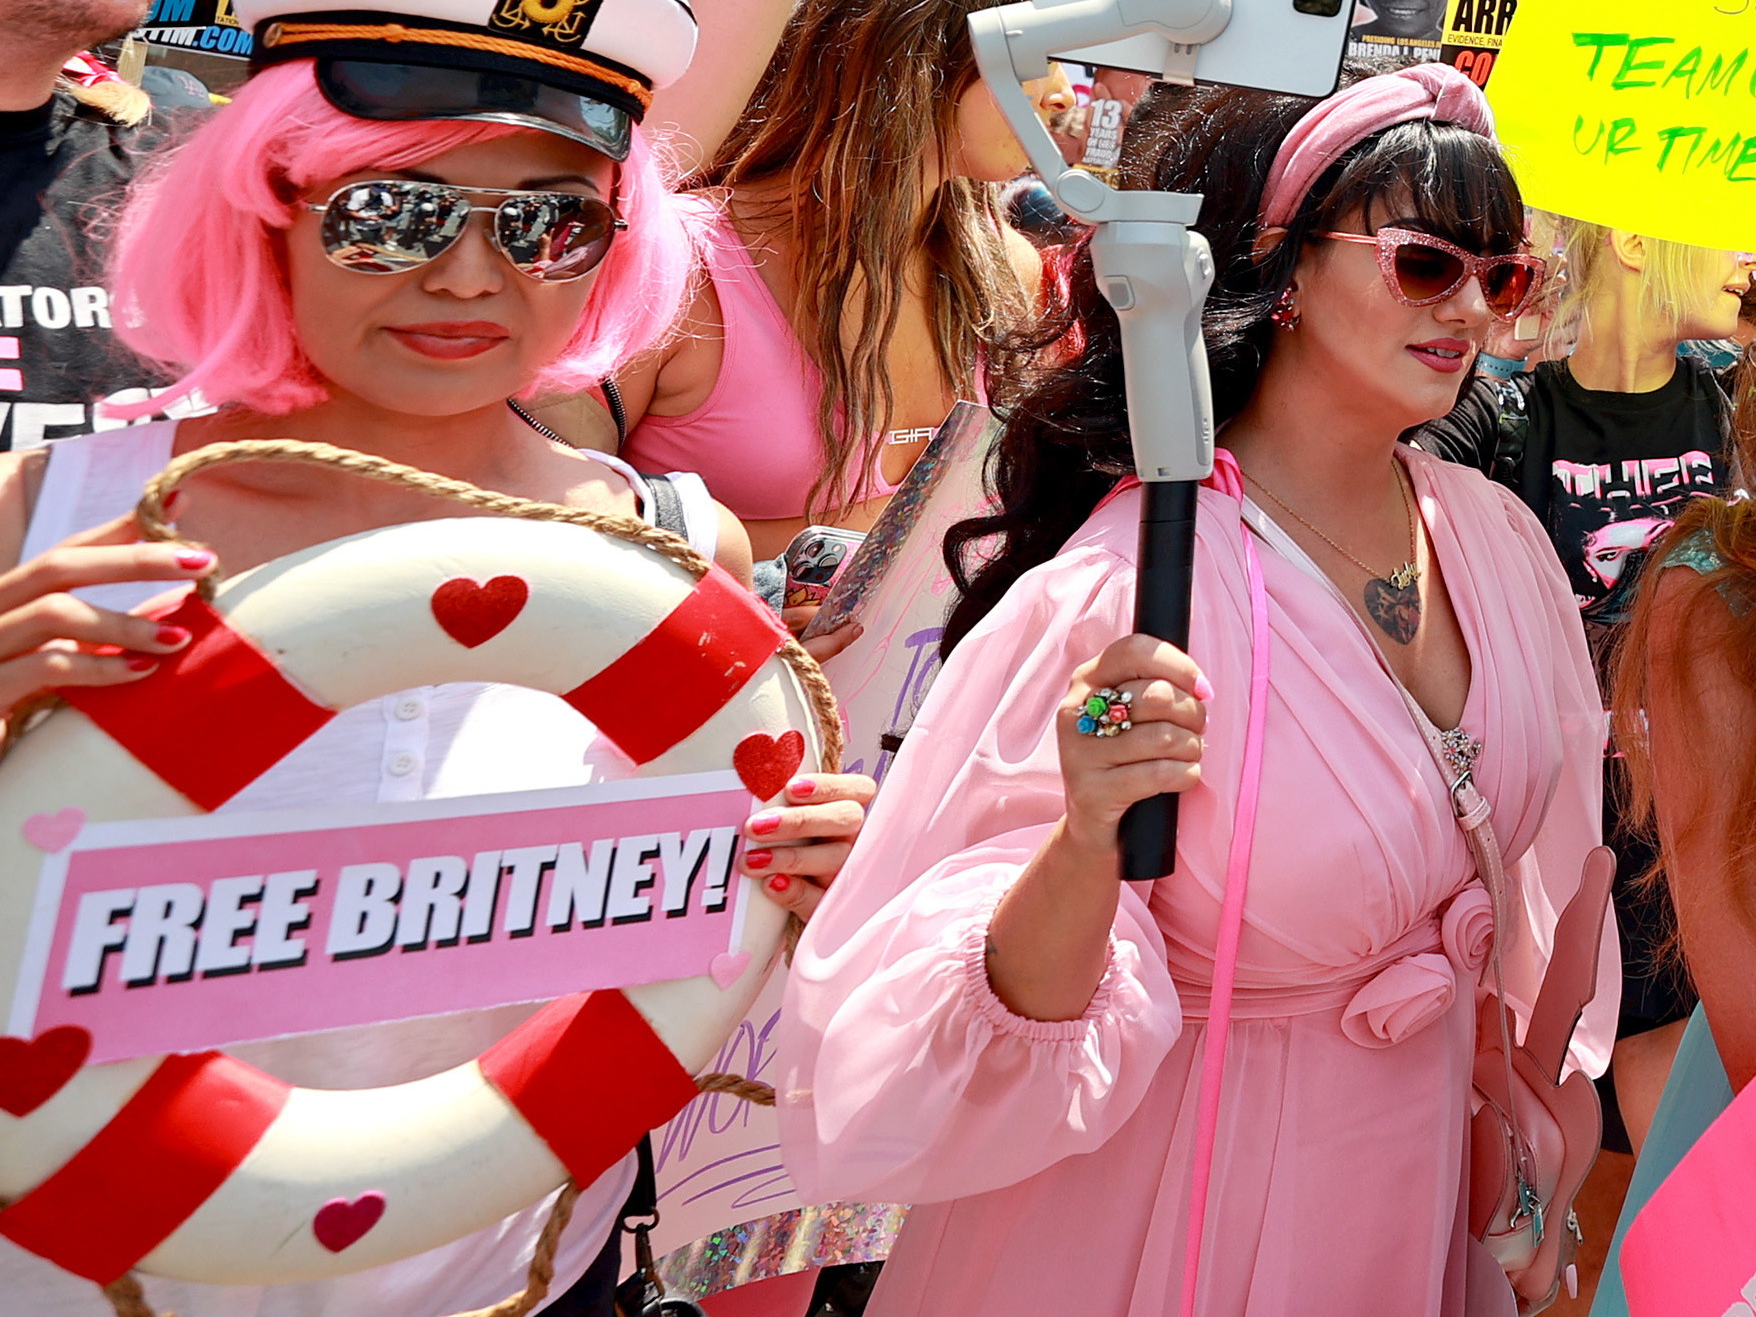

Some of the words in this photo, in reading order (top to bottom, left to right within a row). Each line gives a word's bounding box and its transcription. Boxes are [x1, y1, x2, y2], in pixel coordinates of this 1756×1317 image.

[1090, 99, 1122, 130] 13
[1574, 114, 1642, 166] UR
[64, 869, 314, 996] FREE
[324, 827, 738, 962] BRITNEY!
